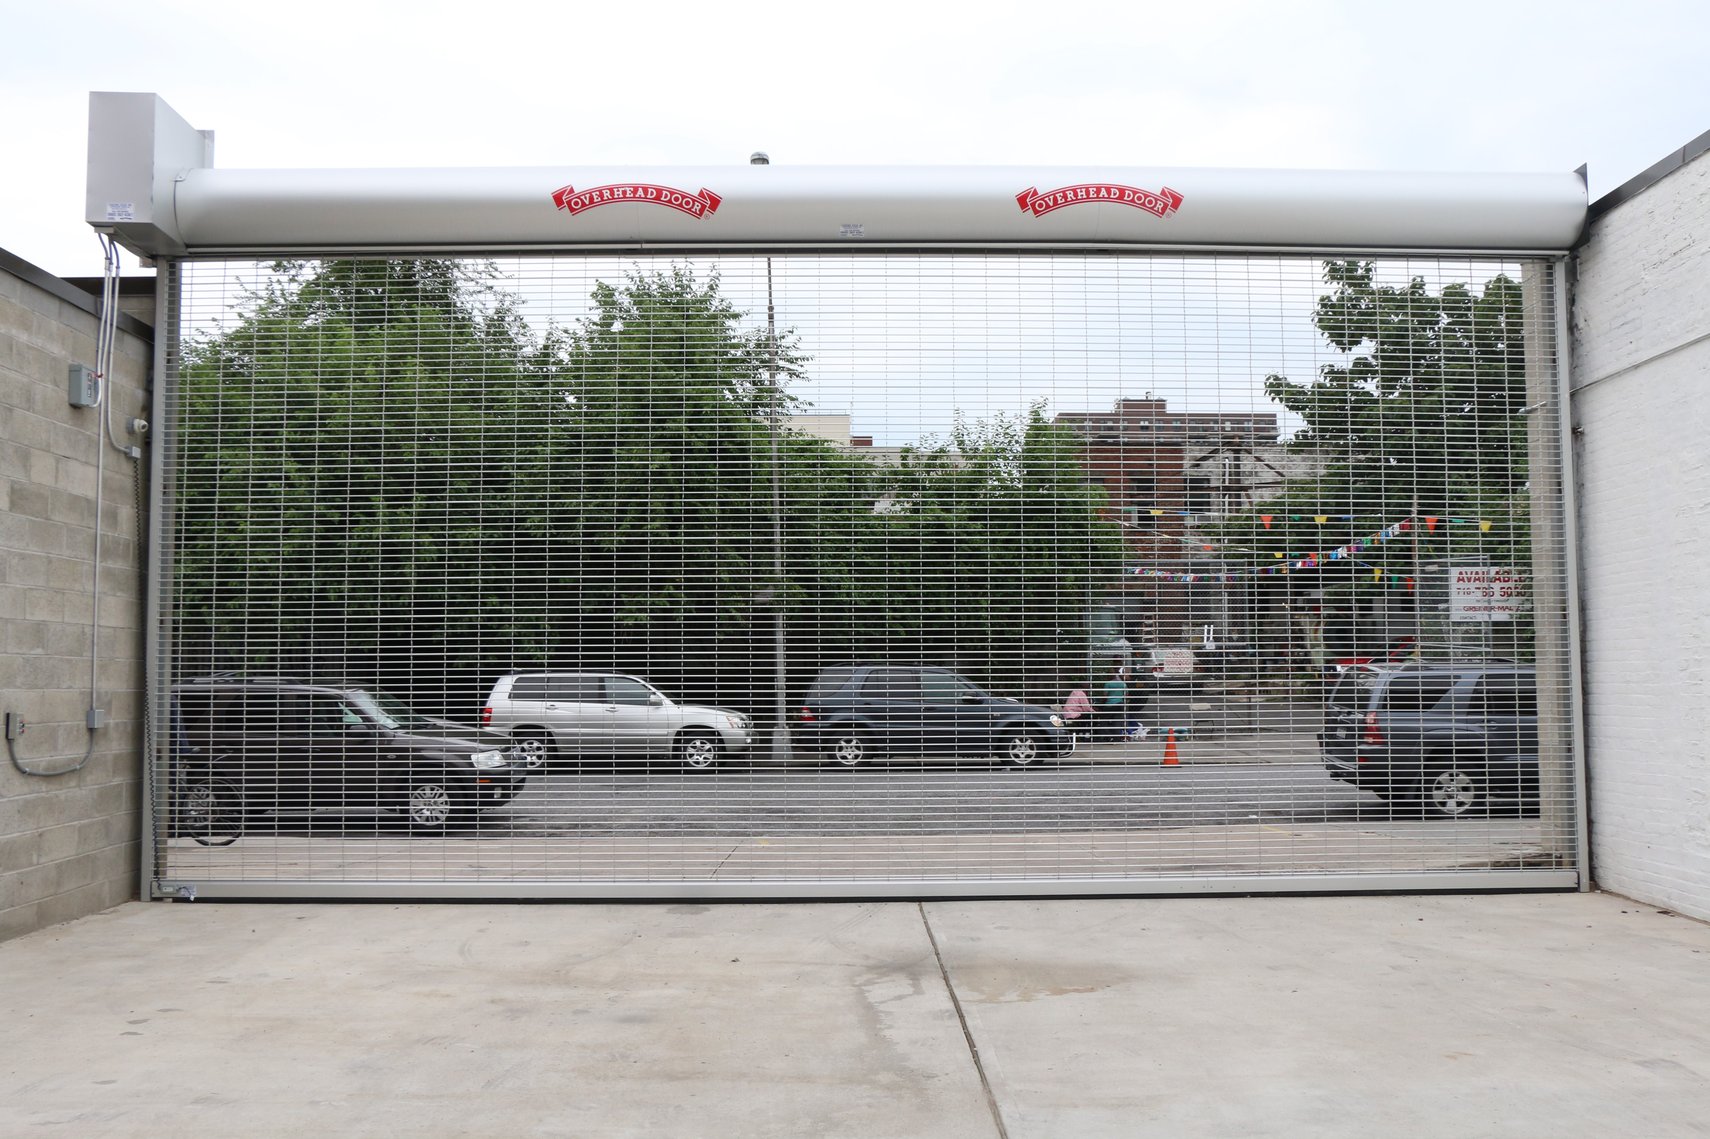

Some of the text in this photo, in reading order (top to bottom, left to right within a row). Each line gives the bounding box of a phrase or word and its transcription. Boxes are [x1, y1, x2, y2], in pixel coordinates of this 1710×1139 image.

[571, 187, 702, 214] OVERHEAD DOOR
[1035, 187, 1164, 213] OVERHEAD DOOR
